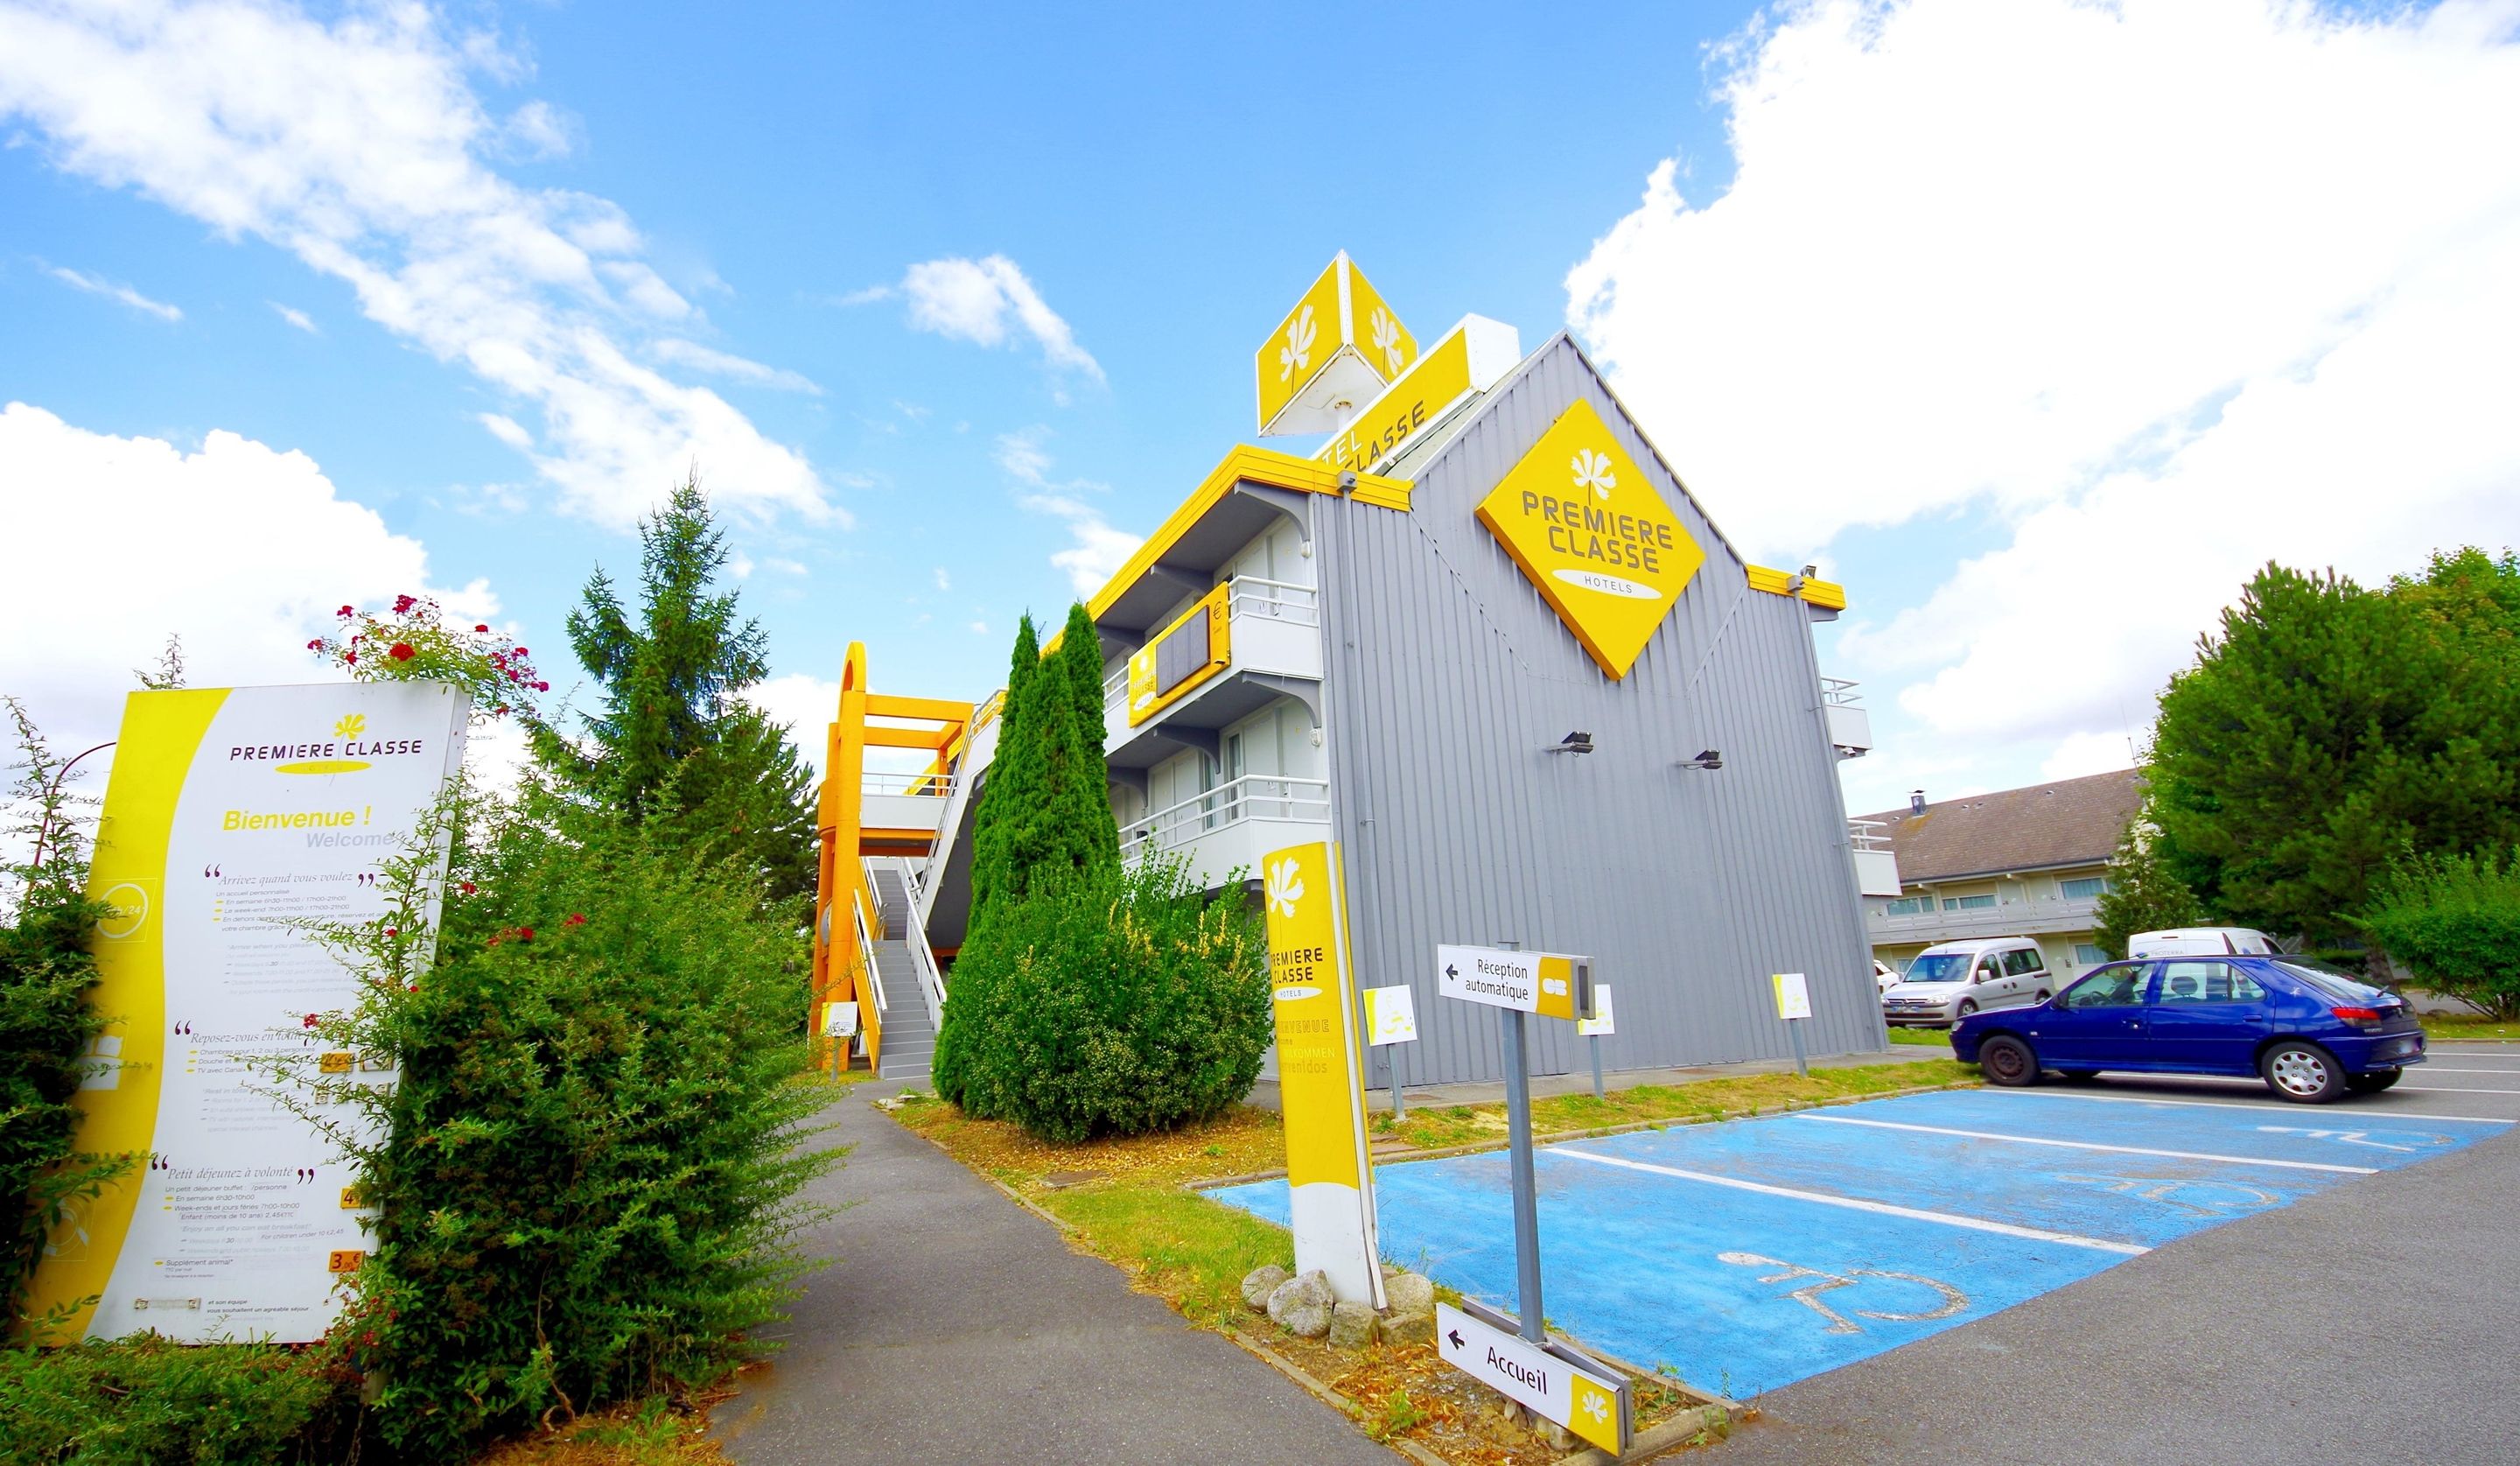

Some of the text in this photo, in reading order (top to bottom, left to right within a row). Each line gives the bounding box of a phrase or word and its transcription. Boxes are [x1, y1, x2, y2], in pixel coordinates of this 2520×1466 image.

[1522, 490, 1673, 550] PREMIERE
[1549, 525, 1660, 574] CLASSE
[1584, 575, 1633, 594] HOTELS
[230, 740, 422, 761] PREMIERE CLASSE
[223, 810, 355, 831] Bienvenue
[306, 831, 393, 848] Welcome
[218, 871, 353, 887] Arrivez quand vous voulez
[1275, 966, 1313, 984] CLASSE
[1477, 958, 1528, 980] Réception
[1466, 979, 1529, 1002] automatique
[1276, 1019, 1330, 1034] VENUE
[191, 1033, 258, 1045] Reposez-vous
[168, 1166, 293, 1182] Petit déjeunez à volonté
[1487, 1346, 1547, 1395] Accueil
